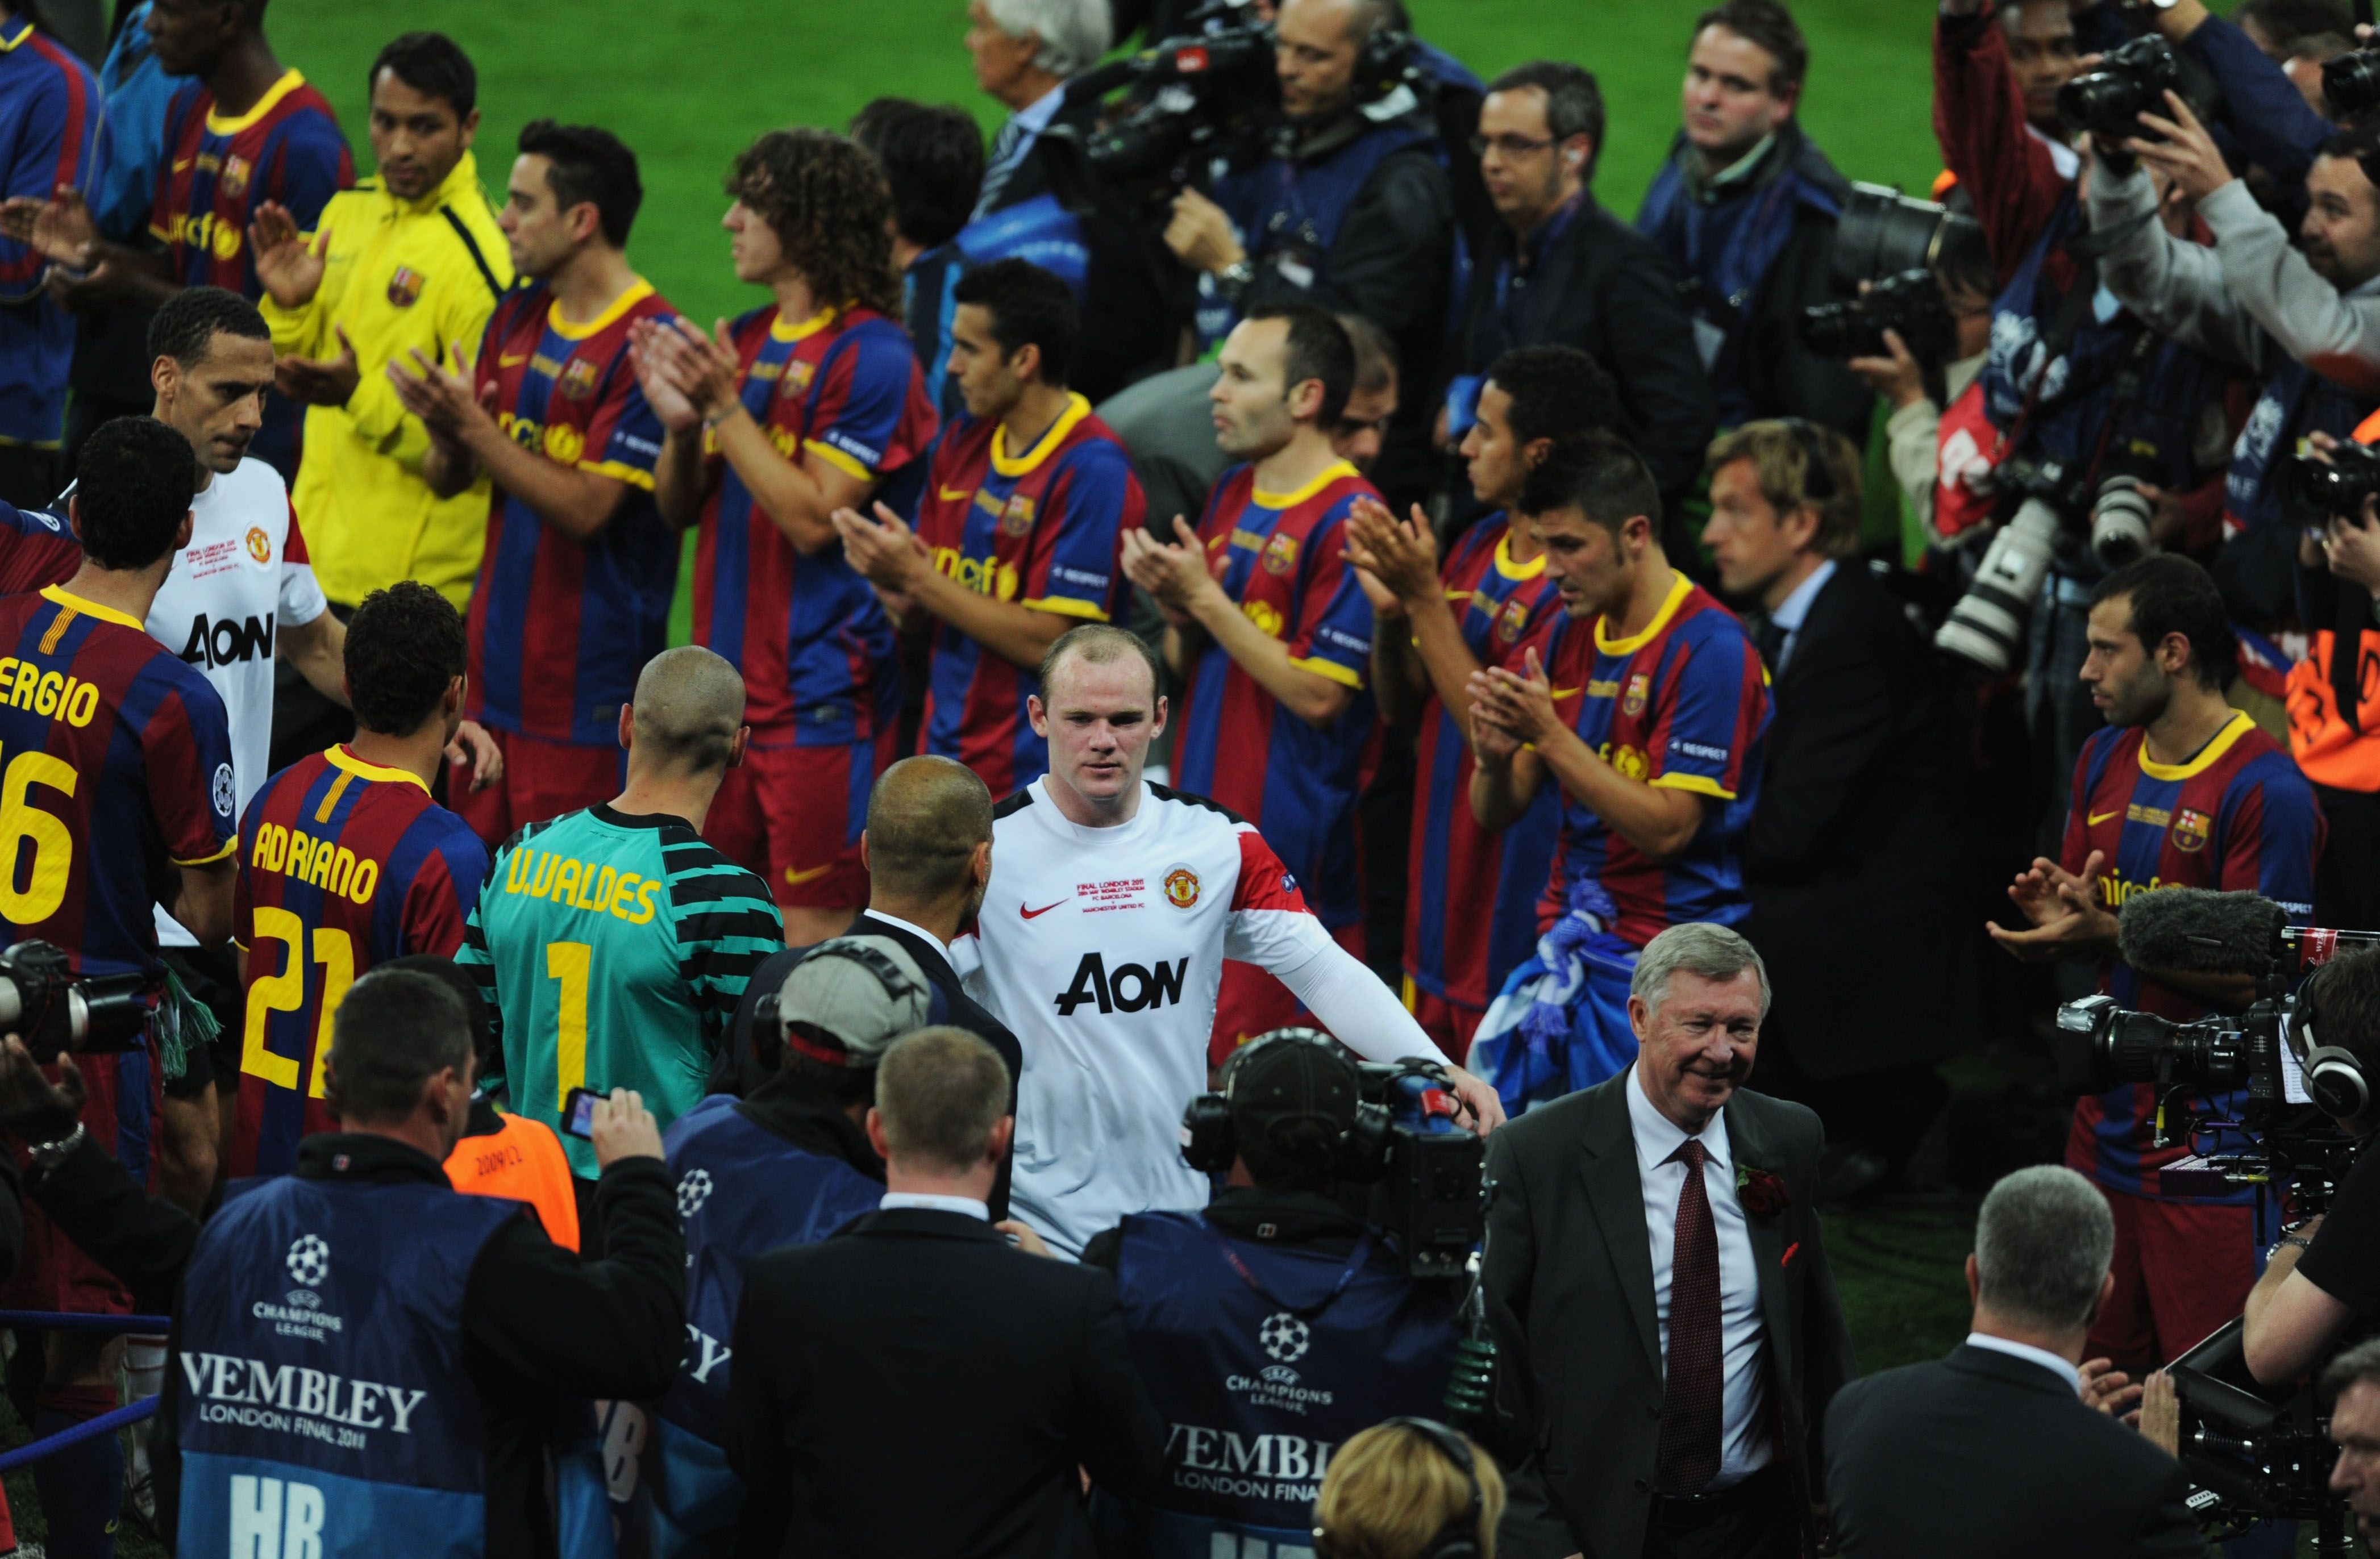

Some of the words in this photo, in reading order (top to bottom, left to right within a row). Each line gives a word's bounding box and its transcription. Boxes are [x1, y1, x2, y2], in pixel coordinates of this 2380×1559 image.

[179, 612, 273, 671] AON
[1683, 743, 1728, 761] RESPECT
[0, 742, 78, 925] 6
[252, 822, 378, 904] ADRIANO
[1099, 879, 1129, 888] LONDON
[240, 907, 355, 1099] 21
[1054, 952, 1189, 1016] AON
[547, 941, 592, 1112] 1
[253, 1302, 343, 1332] CHAMPIONS
[275, 1321, 324, 1341] LEAGUE
[1226, 1375, 1333, 1406] CHAMPIONS
[1251, 1392, 1304, 1412] LEAGUE
[200, 1403, 291, 1433] LONDON
[294, 1416, 335, 1444] FINAL
[338, 1427, 367, 1450] 2011
[1174, 1469, 1268, 1499] LONDON
[1275, 1483, 1320, 1502] FINA
